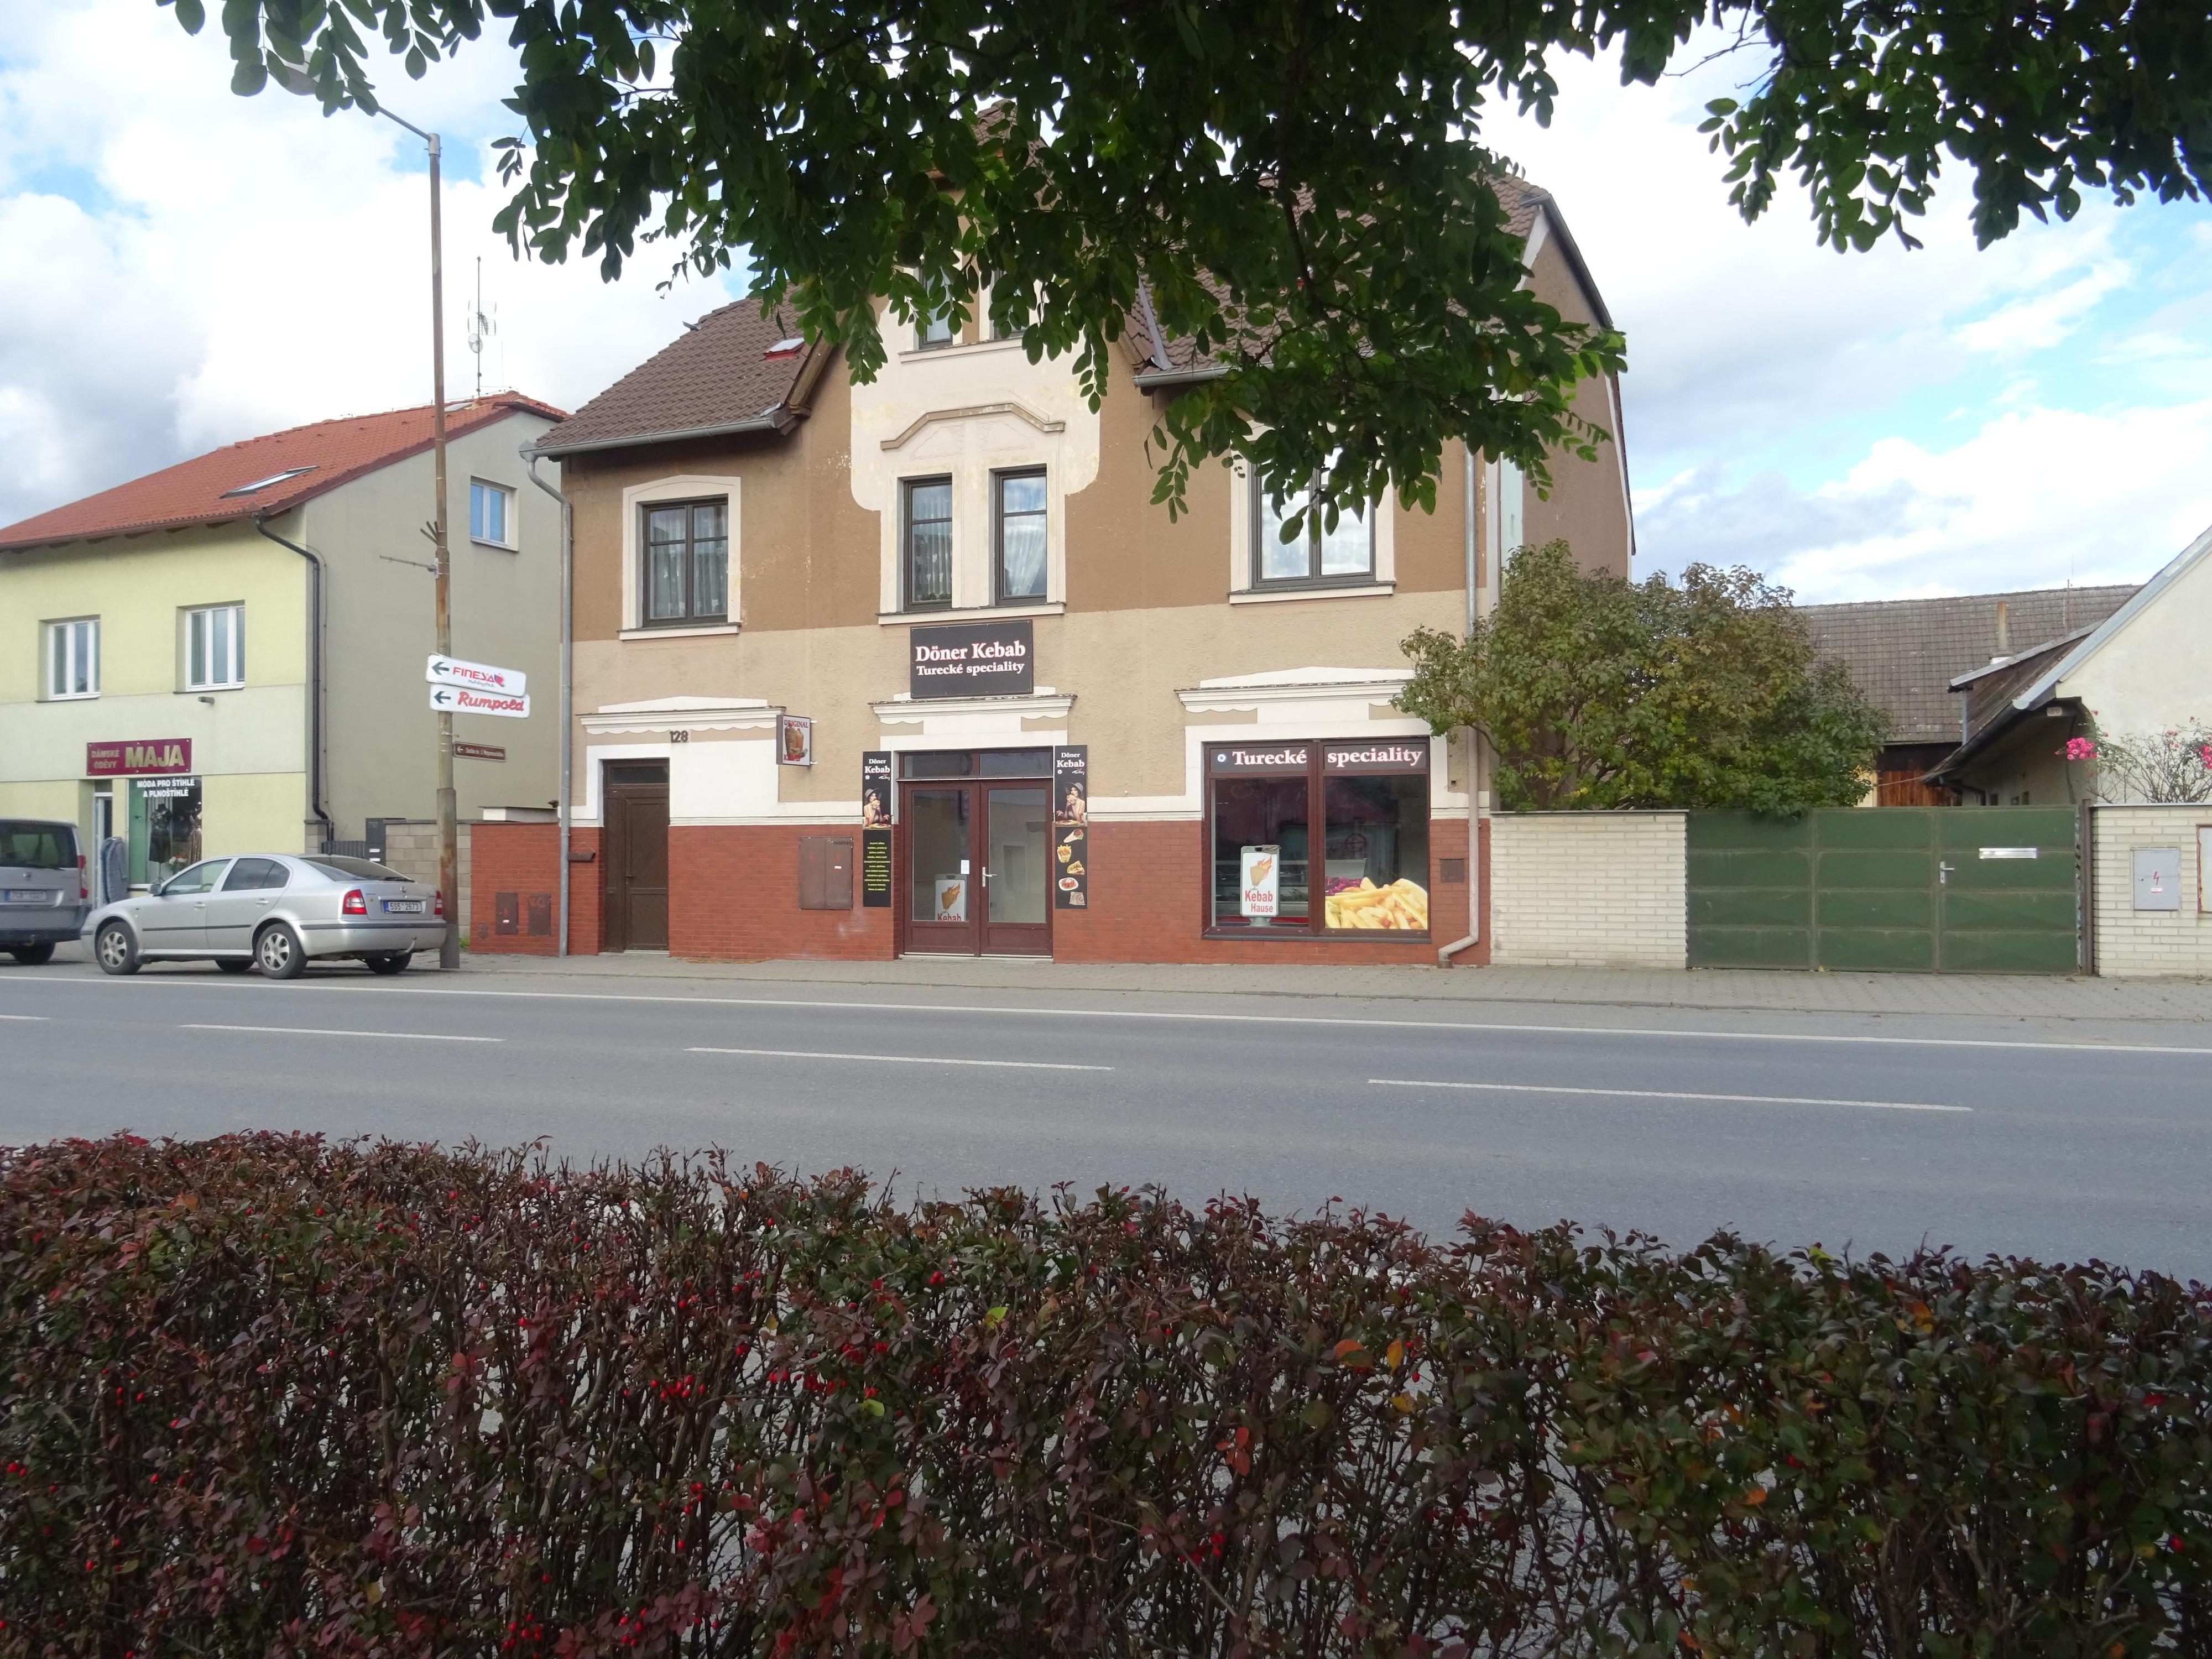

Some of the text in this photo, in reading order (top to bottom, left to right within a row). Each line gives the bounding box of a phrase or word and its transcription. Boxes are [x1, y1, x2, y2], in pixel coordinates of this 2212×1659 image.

[915, 640, 1026, 661] Döner Kebab
[916, 661, 1025, 676] Turecké speciality
[457, 691, 524, 711] Rumpold
[784, 719, 808, 728] ORIGINAL
[669, 730, 688, 743] 128
[125, 745, 185, 768] MAJA
[1232, 747, 1423, 767] Turecké speciality
[1056, 759, 1085, 768] Kebab
[1245, 890, 1274, 902] Kebab
[1251, 902, 1274, 912] Hause
[937, 913, 961, 921] Kebab
